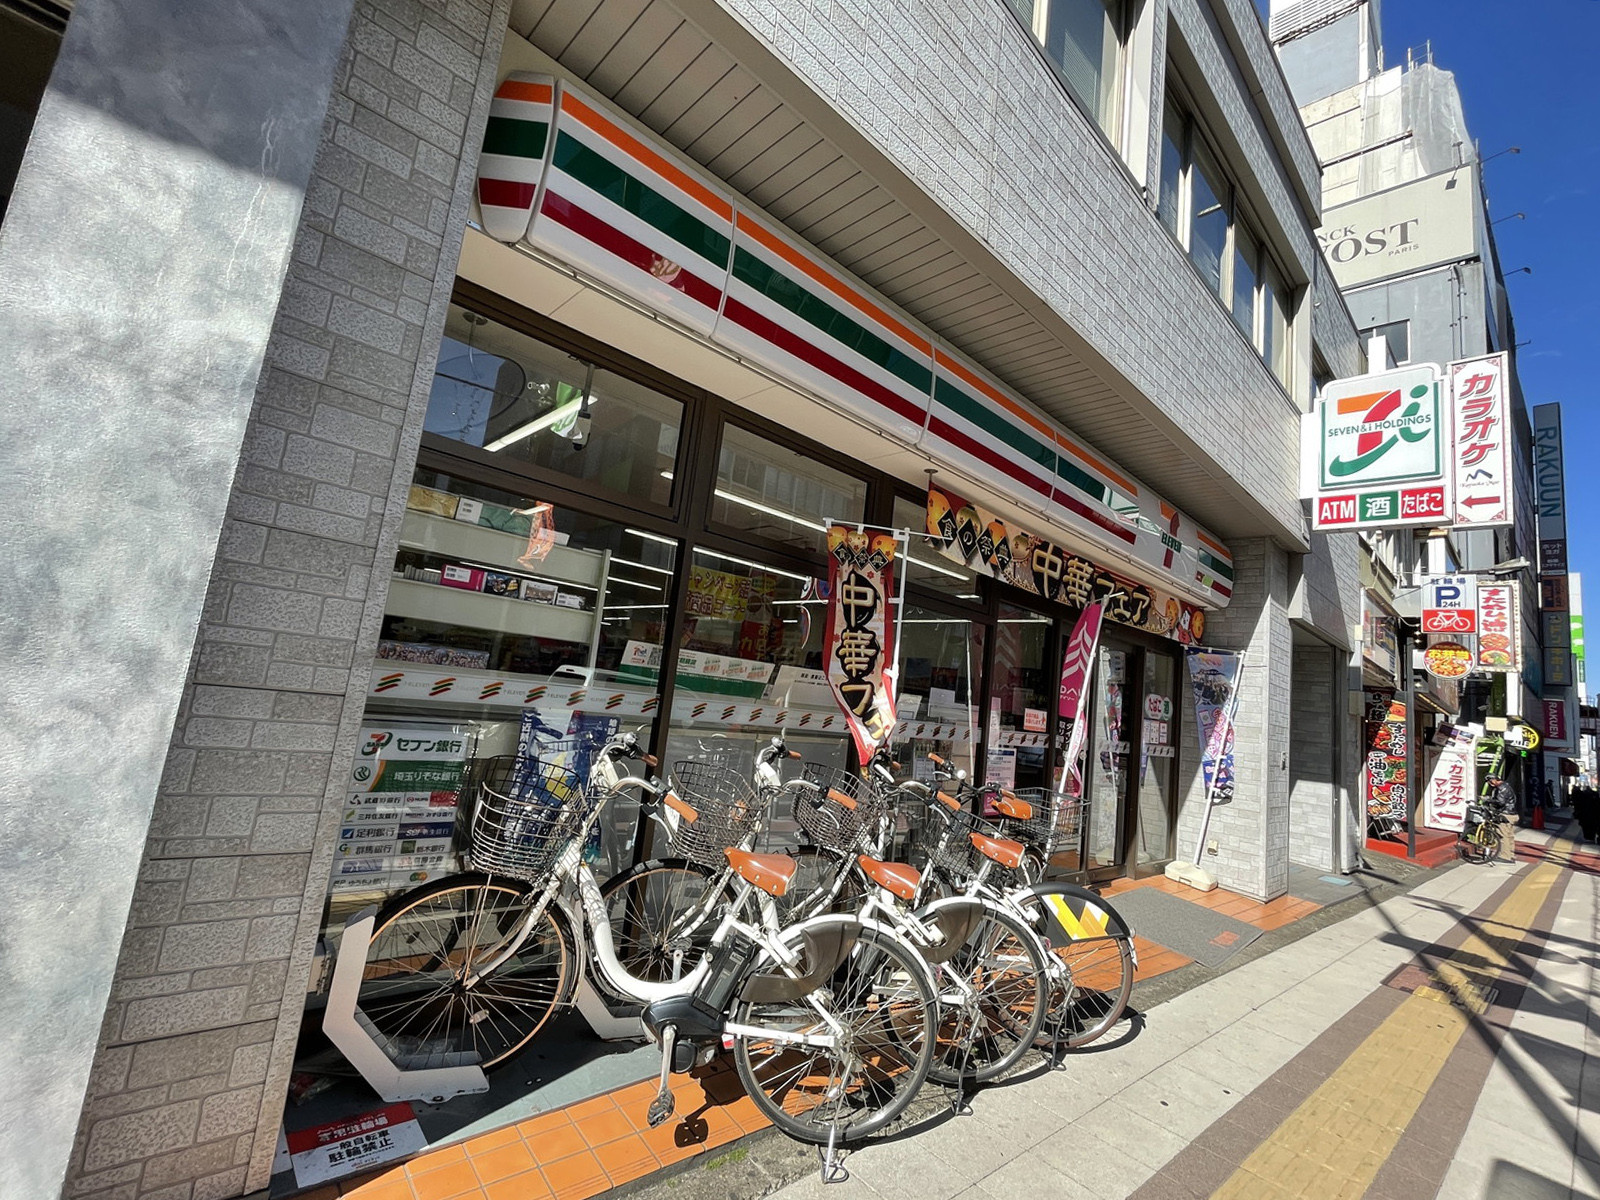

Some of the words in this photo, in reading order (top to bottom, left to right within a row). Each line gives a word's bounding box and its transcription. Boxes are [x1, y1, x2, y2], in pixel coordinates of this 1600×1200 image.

[1388, 244, 1419, 256] PARIS
[1374, 414, 1432, 431] HOLDINGS
[1459, 373, 1499, 467] カラオケ
[1320, 500, 1354, 520] ATM
[1365, 496, 1391, 518] 酒
[1402, 492, 1443, 514] たばこ
[1032, 542, 1151, 623] 中華フェア
[1435, 586, 1461, 608] P
[1548, 701, 1559, 739] RAKUEN
[396, 738, 462, 753] セブン銀行
[393, 771, 460, 781] 埼玉りそな銀行
[1449, 764, 1464, 805] カラオケ
[1434, 778, 1448, 807] マック
[355, 829, 396, 838] 足利銀行
[326, 1129, 390, 1152] 一般自転車
[328, 1137, 394, 1163] 駐輪禁止
